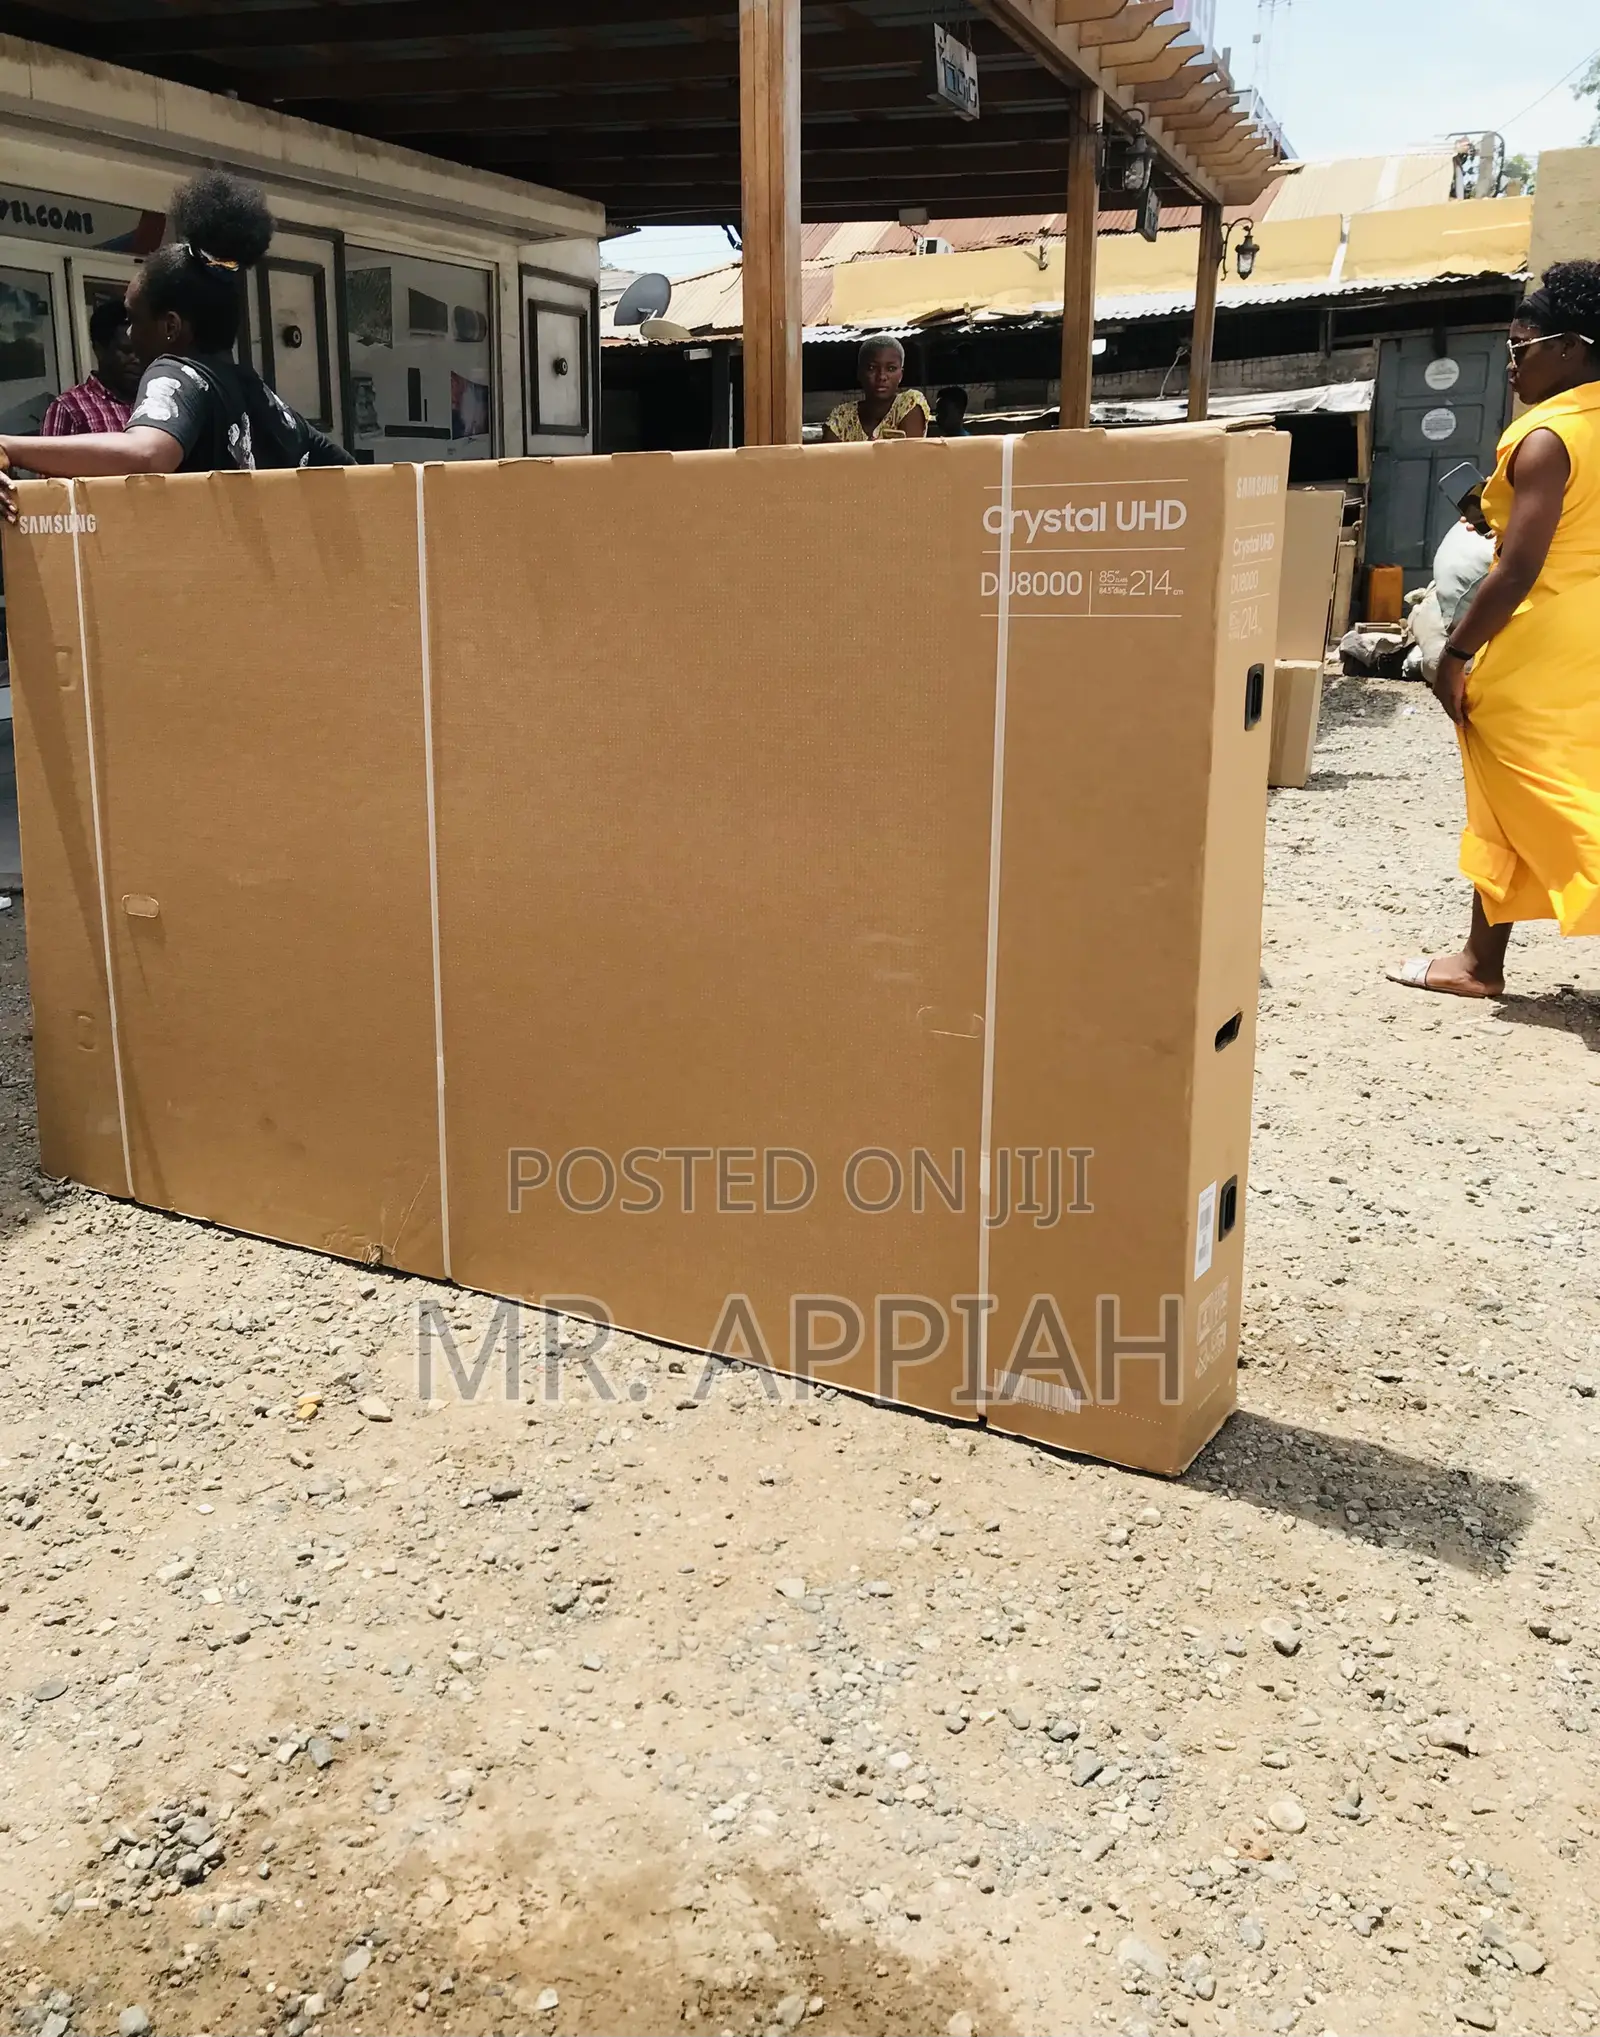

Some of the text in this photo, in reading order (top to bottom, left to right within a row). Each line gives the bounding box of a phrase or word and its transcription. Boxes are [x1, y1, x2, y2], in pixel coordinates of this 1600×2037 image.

[1236, 474, 1280, 499] SAMSUNG
[19, 513, 97, 535] SAMSUNG
[982, 499, 1188, 544] Crystal UHD
[1129, 569, 1173, 596] 214
